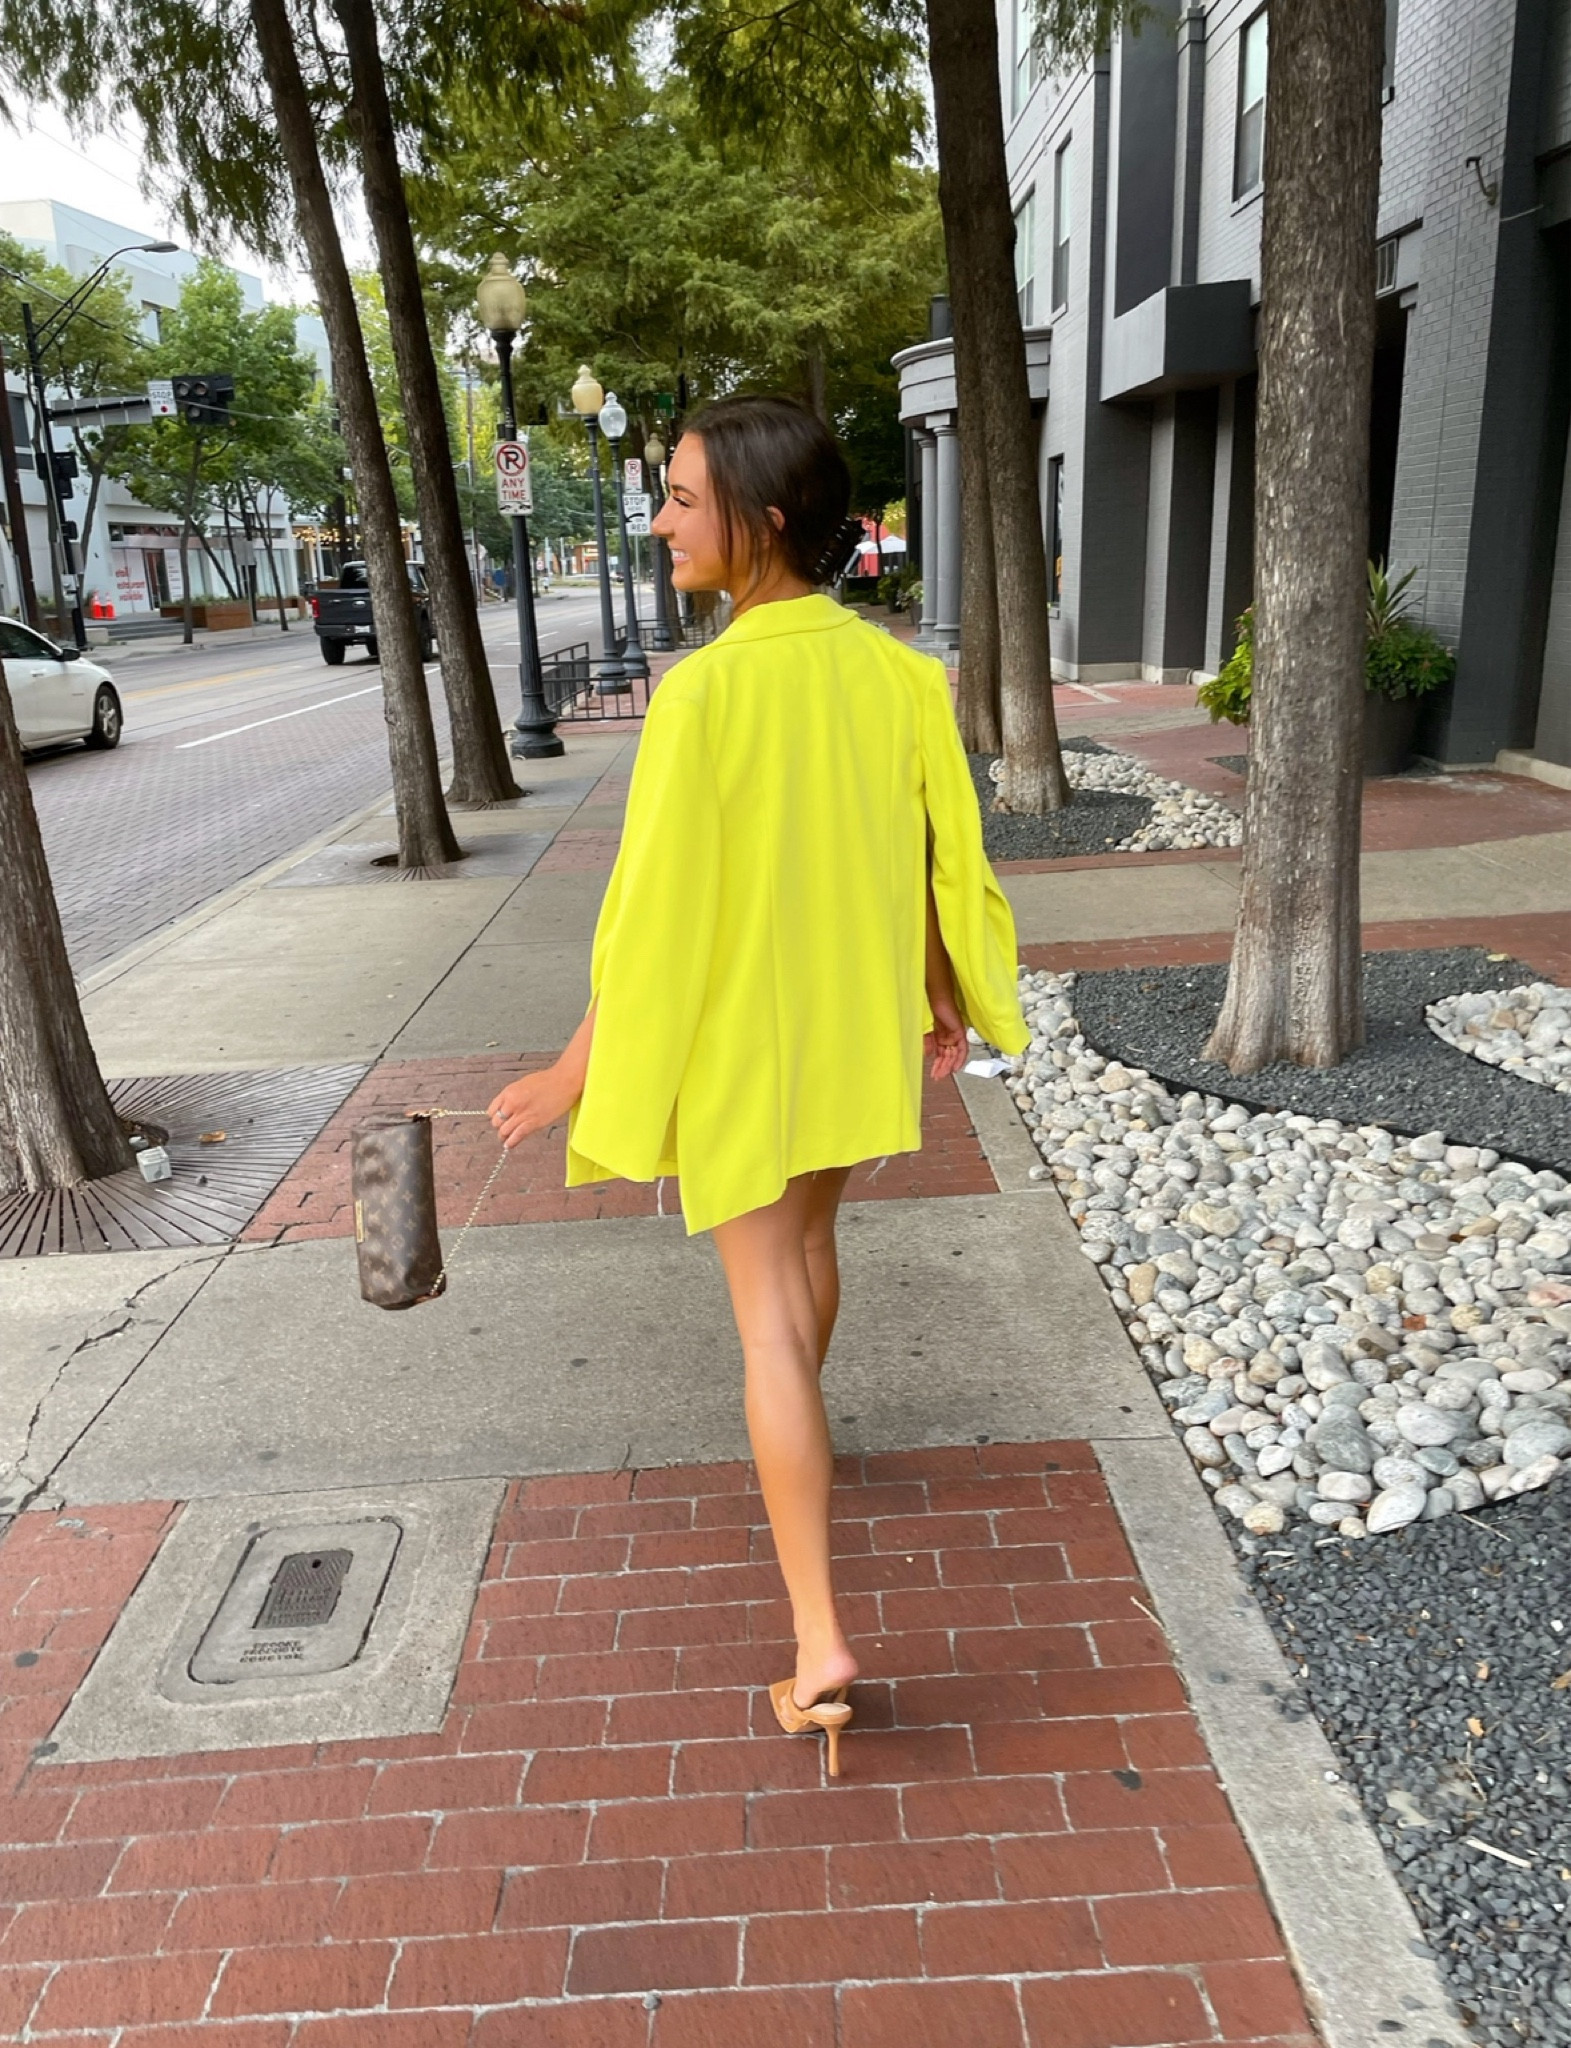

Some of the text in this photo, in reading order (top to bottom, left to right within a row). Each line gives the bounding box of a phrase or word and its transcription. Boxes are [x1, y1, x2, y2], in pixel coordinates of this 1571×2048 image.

[501, 478, 525, 489] ANY
[502, 490, 527, 500] TIME
[624, 497, 646, 506] STOP
[631, 524, 648, 533] RED
